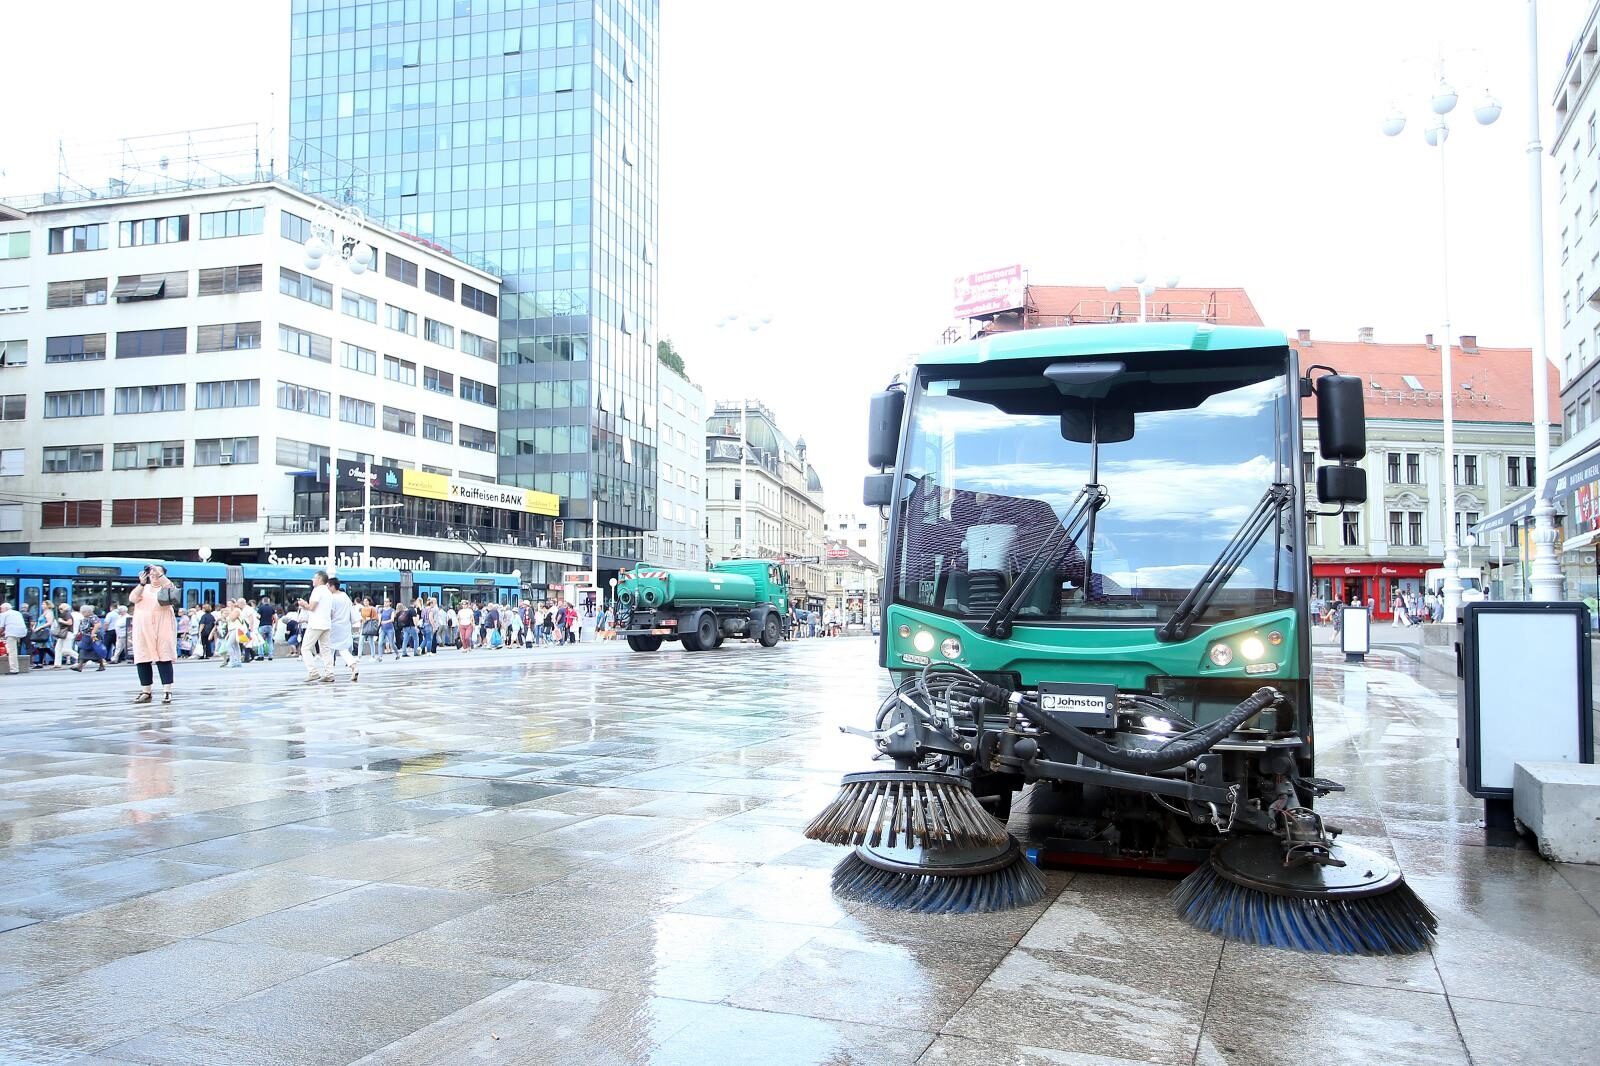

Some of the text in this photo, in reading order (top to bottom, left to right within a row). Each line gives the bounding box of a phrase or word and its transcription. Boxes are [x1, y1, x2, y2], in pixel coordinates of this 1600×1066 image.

[460, 486, 499, 502] Raiffeisen
[500, 493, 522, 506] BANK
[268, 550, 310, 566] Špica
[1057, 696, 1104, 708] Johnston
